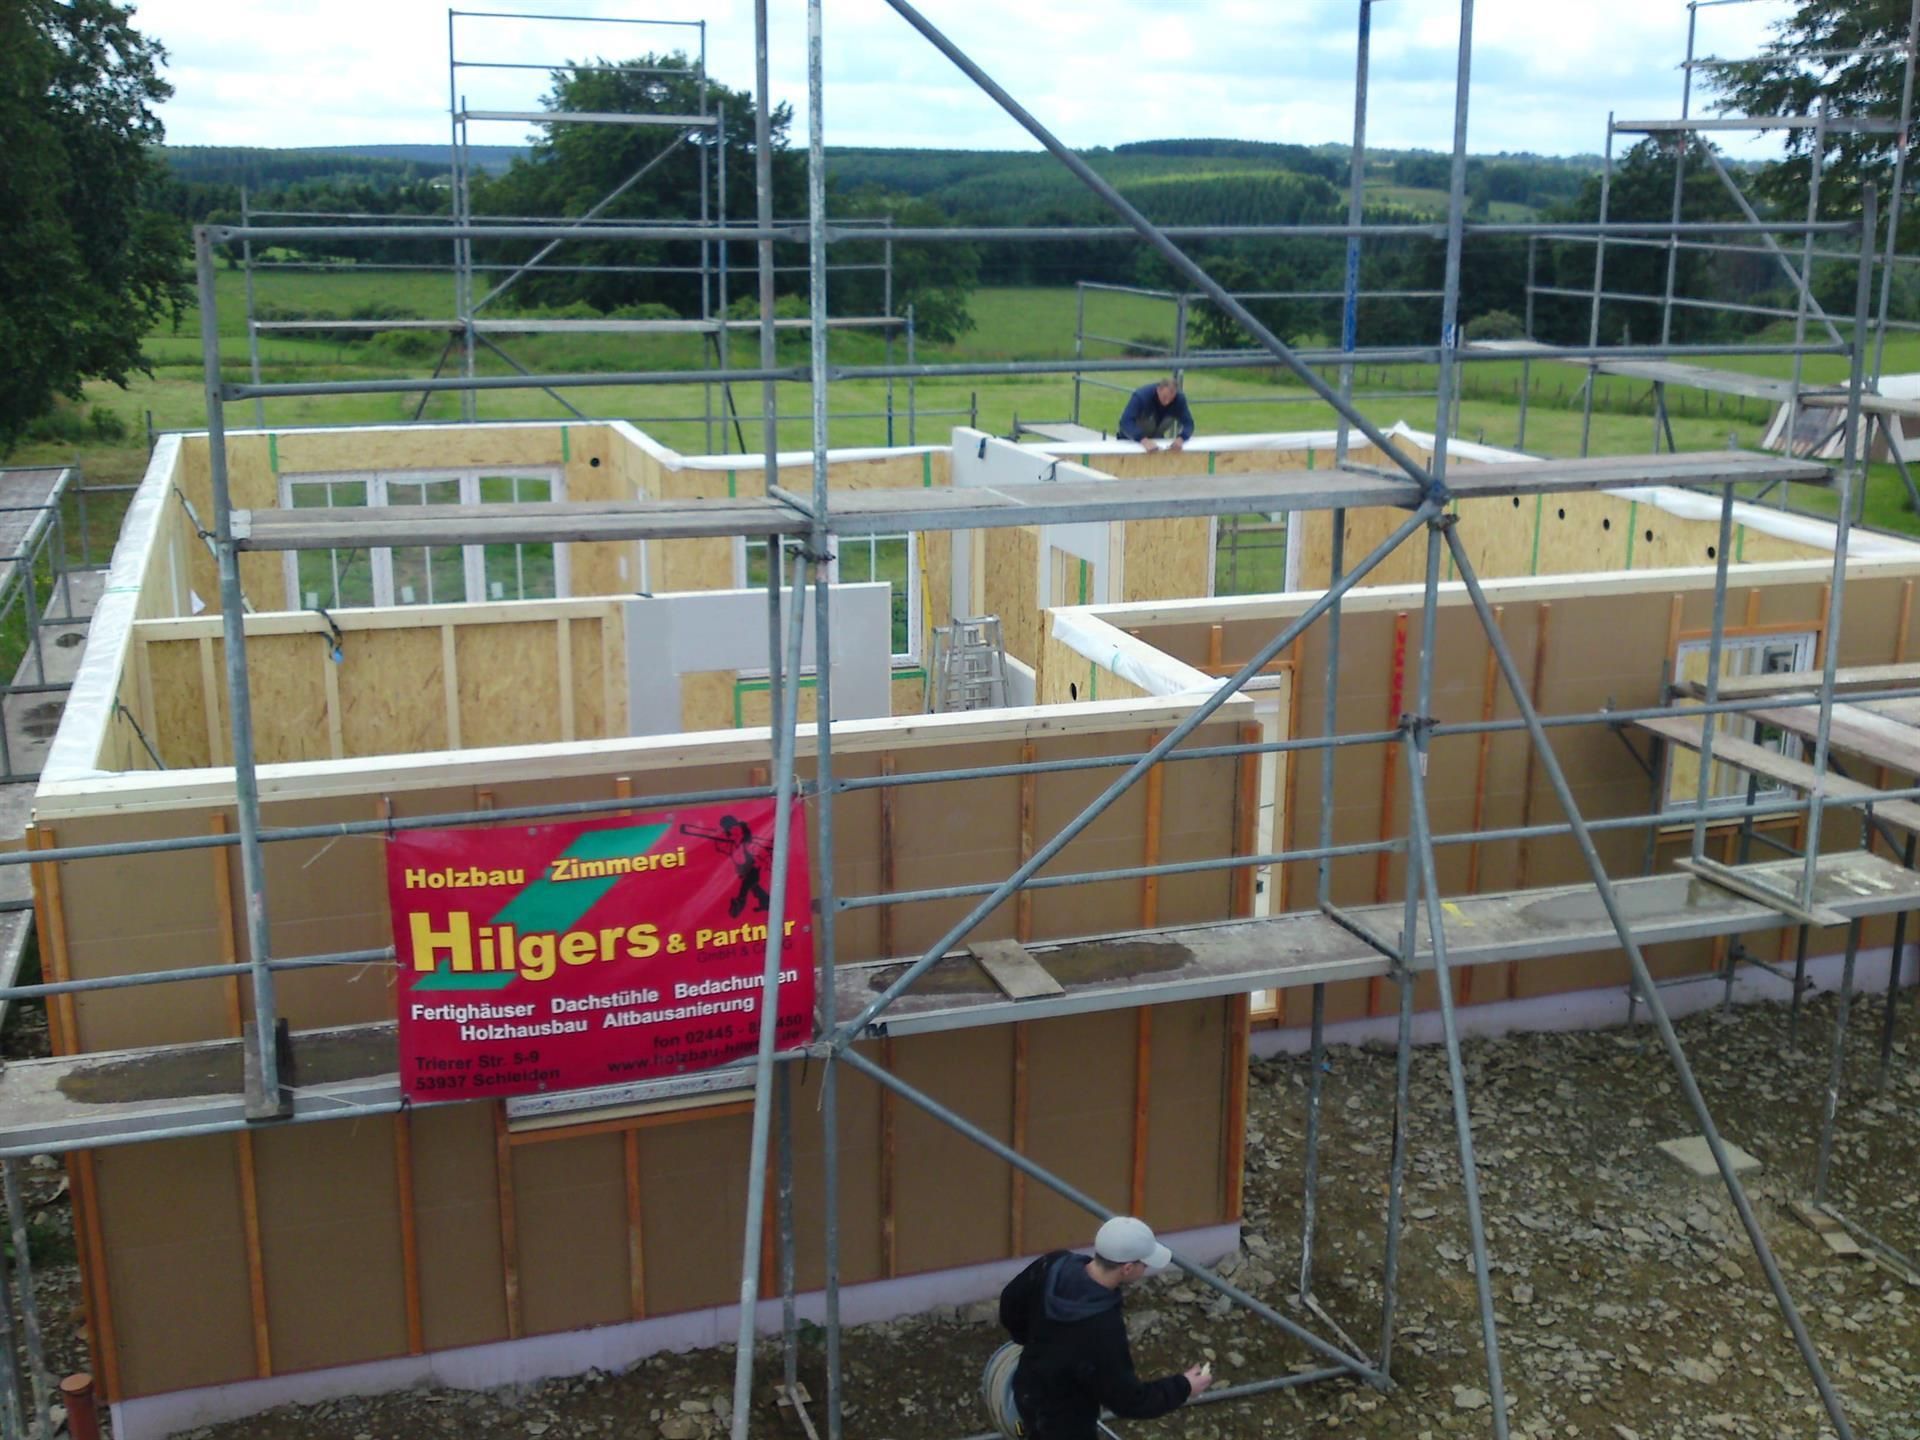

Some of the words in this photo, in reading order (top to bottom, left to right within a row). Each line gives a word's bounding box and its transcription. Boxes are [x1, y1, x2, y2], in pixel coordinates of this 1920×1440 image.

[405, 866, 525, 889] Holzbau
[551, 846, 687, 882] Zimmerei
[409, 911, 660, 981] Hilgers
[666, 932, 687, 954] &
[695, 920, 796, 950] Partnr
[411, 1003, 536, 1023] Fertighäuser
[551, 988, 660, 1014] Dachstühle
[674, 968, 798, 1000] Bedachunen
[460, 1019, 588, 1041] Holzhausbau
[603, 996, 755, 1029] Altbausanierung
[653, 1034, 681, 1049] fon
[685, 1023, 734, 1044] 02445
[415, 1055, 473, 1071] Trierer
[415, 1074, 467, 1091] 53937
[473, 1068, 561, 1088] Schleiden
